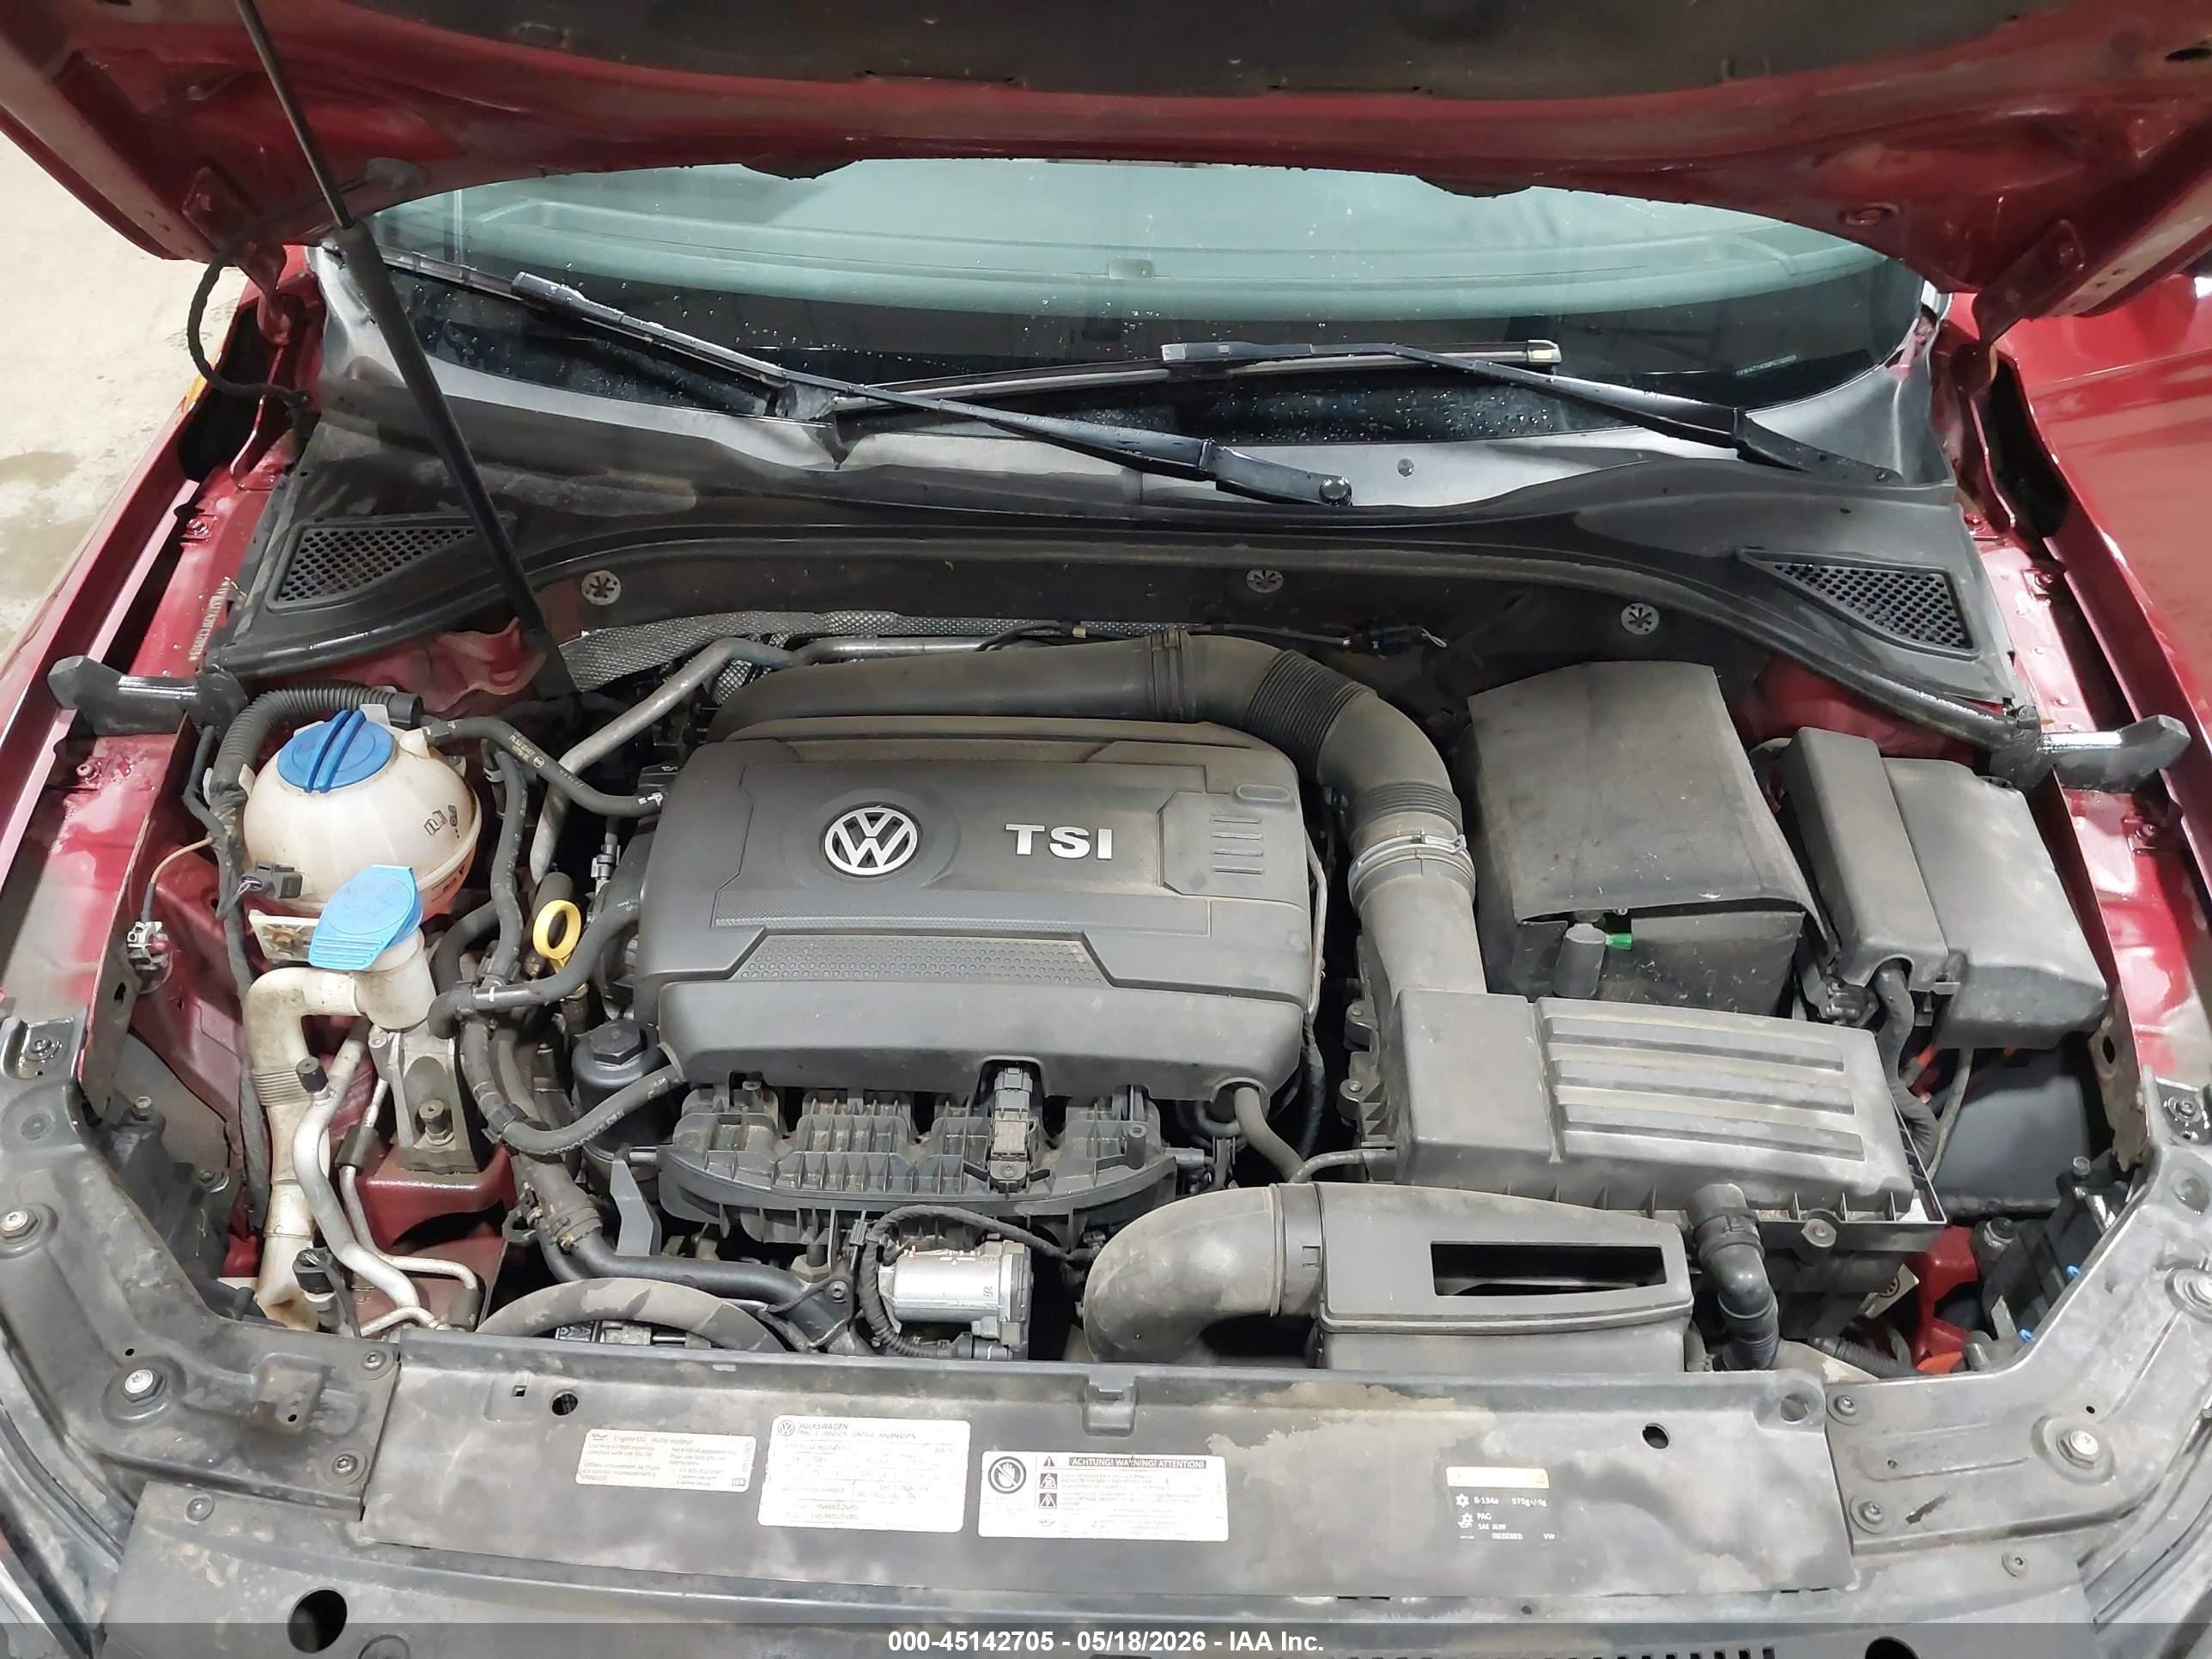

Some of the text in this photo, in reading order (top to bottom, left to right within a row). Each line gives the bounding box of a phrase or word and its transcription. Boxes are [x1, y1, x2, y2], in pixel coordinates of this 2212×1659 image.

[824, 806, 919, 876] VW
[1006, 823, 1112, 860] TSI
[1072, 1457, 1114, 1467] ACHTUNG!
[1159, 1460, 1204, 1469] ATTENTION!
[1477, 1512, 1492, 1521] PAG
